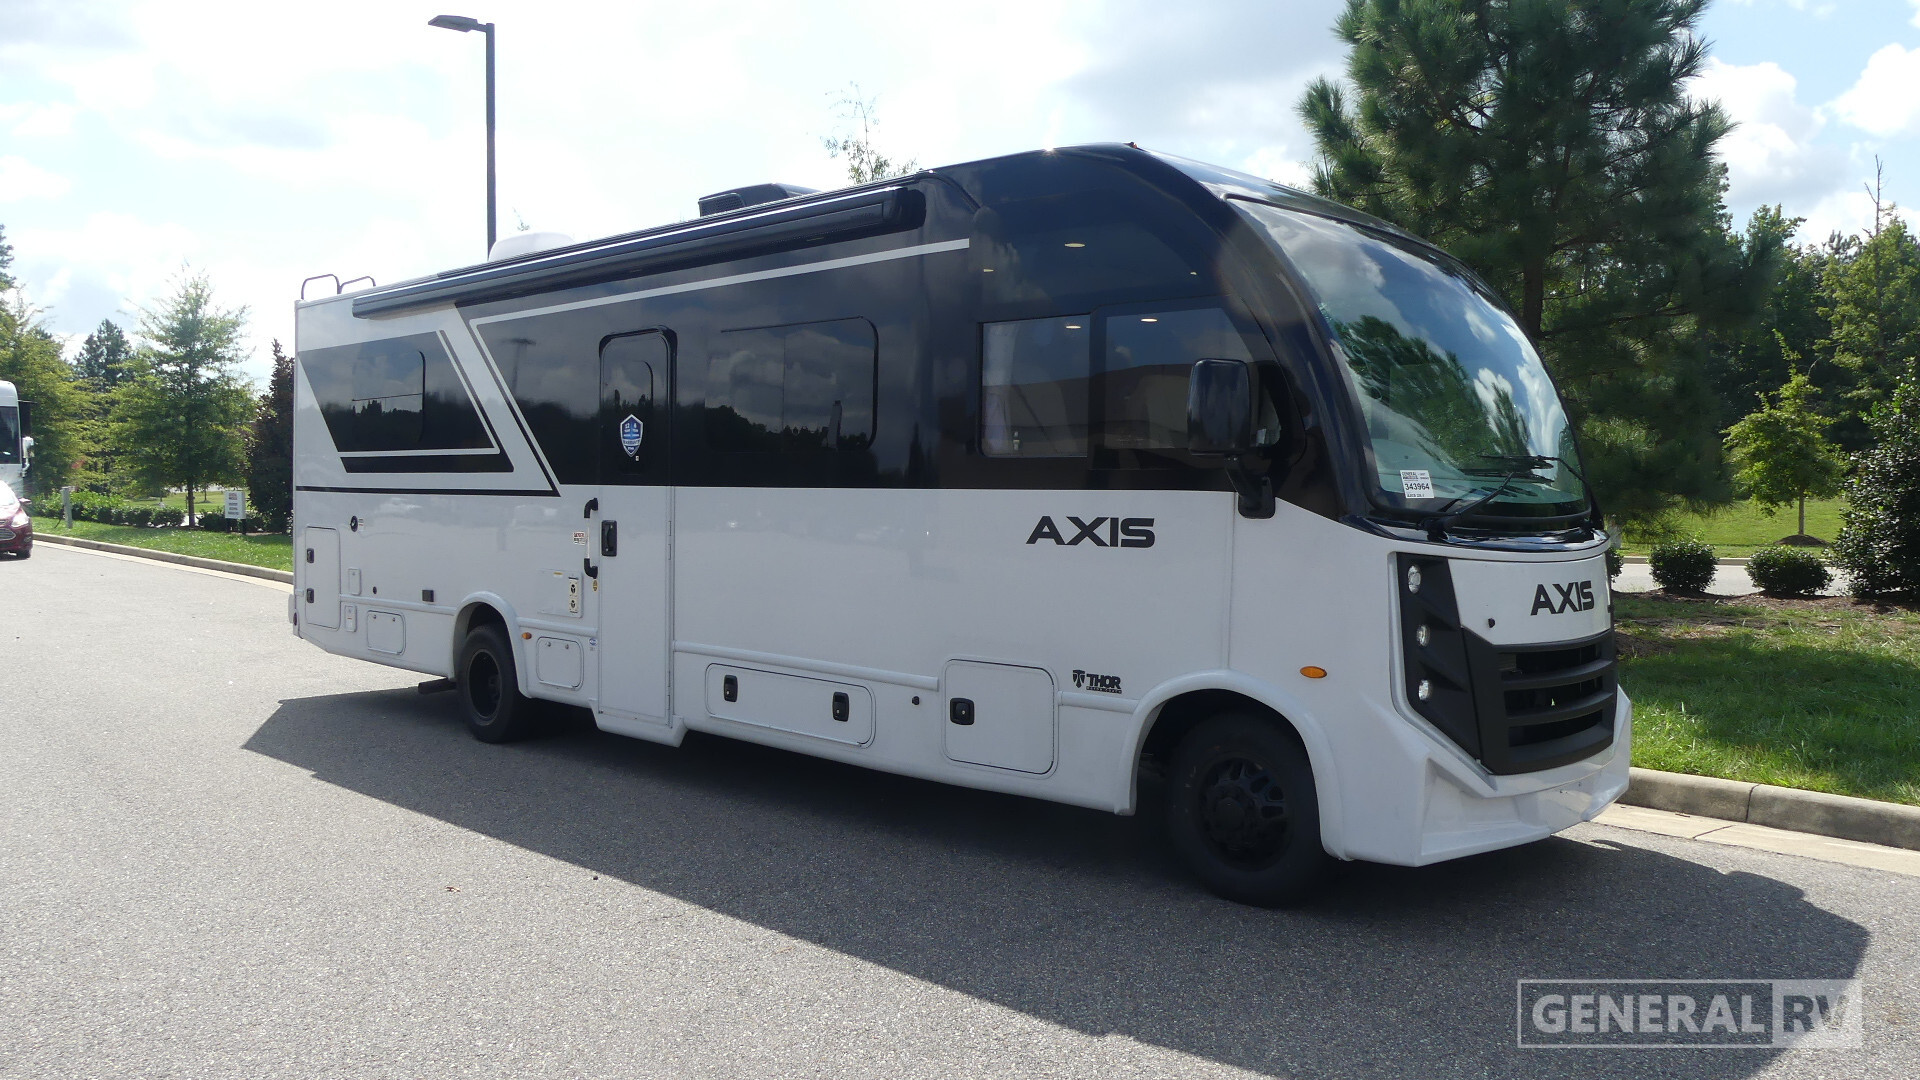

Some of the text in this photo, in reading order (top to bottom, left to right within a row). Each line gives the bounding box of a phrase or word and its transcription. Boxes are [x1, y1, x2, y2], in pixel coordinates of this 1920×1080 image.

[1404, 482, 1430, 490] 343964
[1025, 515, 1156, 549] AXIS
[1530, 580, 1595, 616] AXIS
[1086, 673, 1121, 690] THOR
